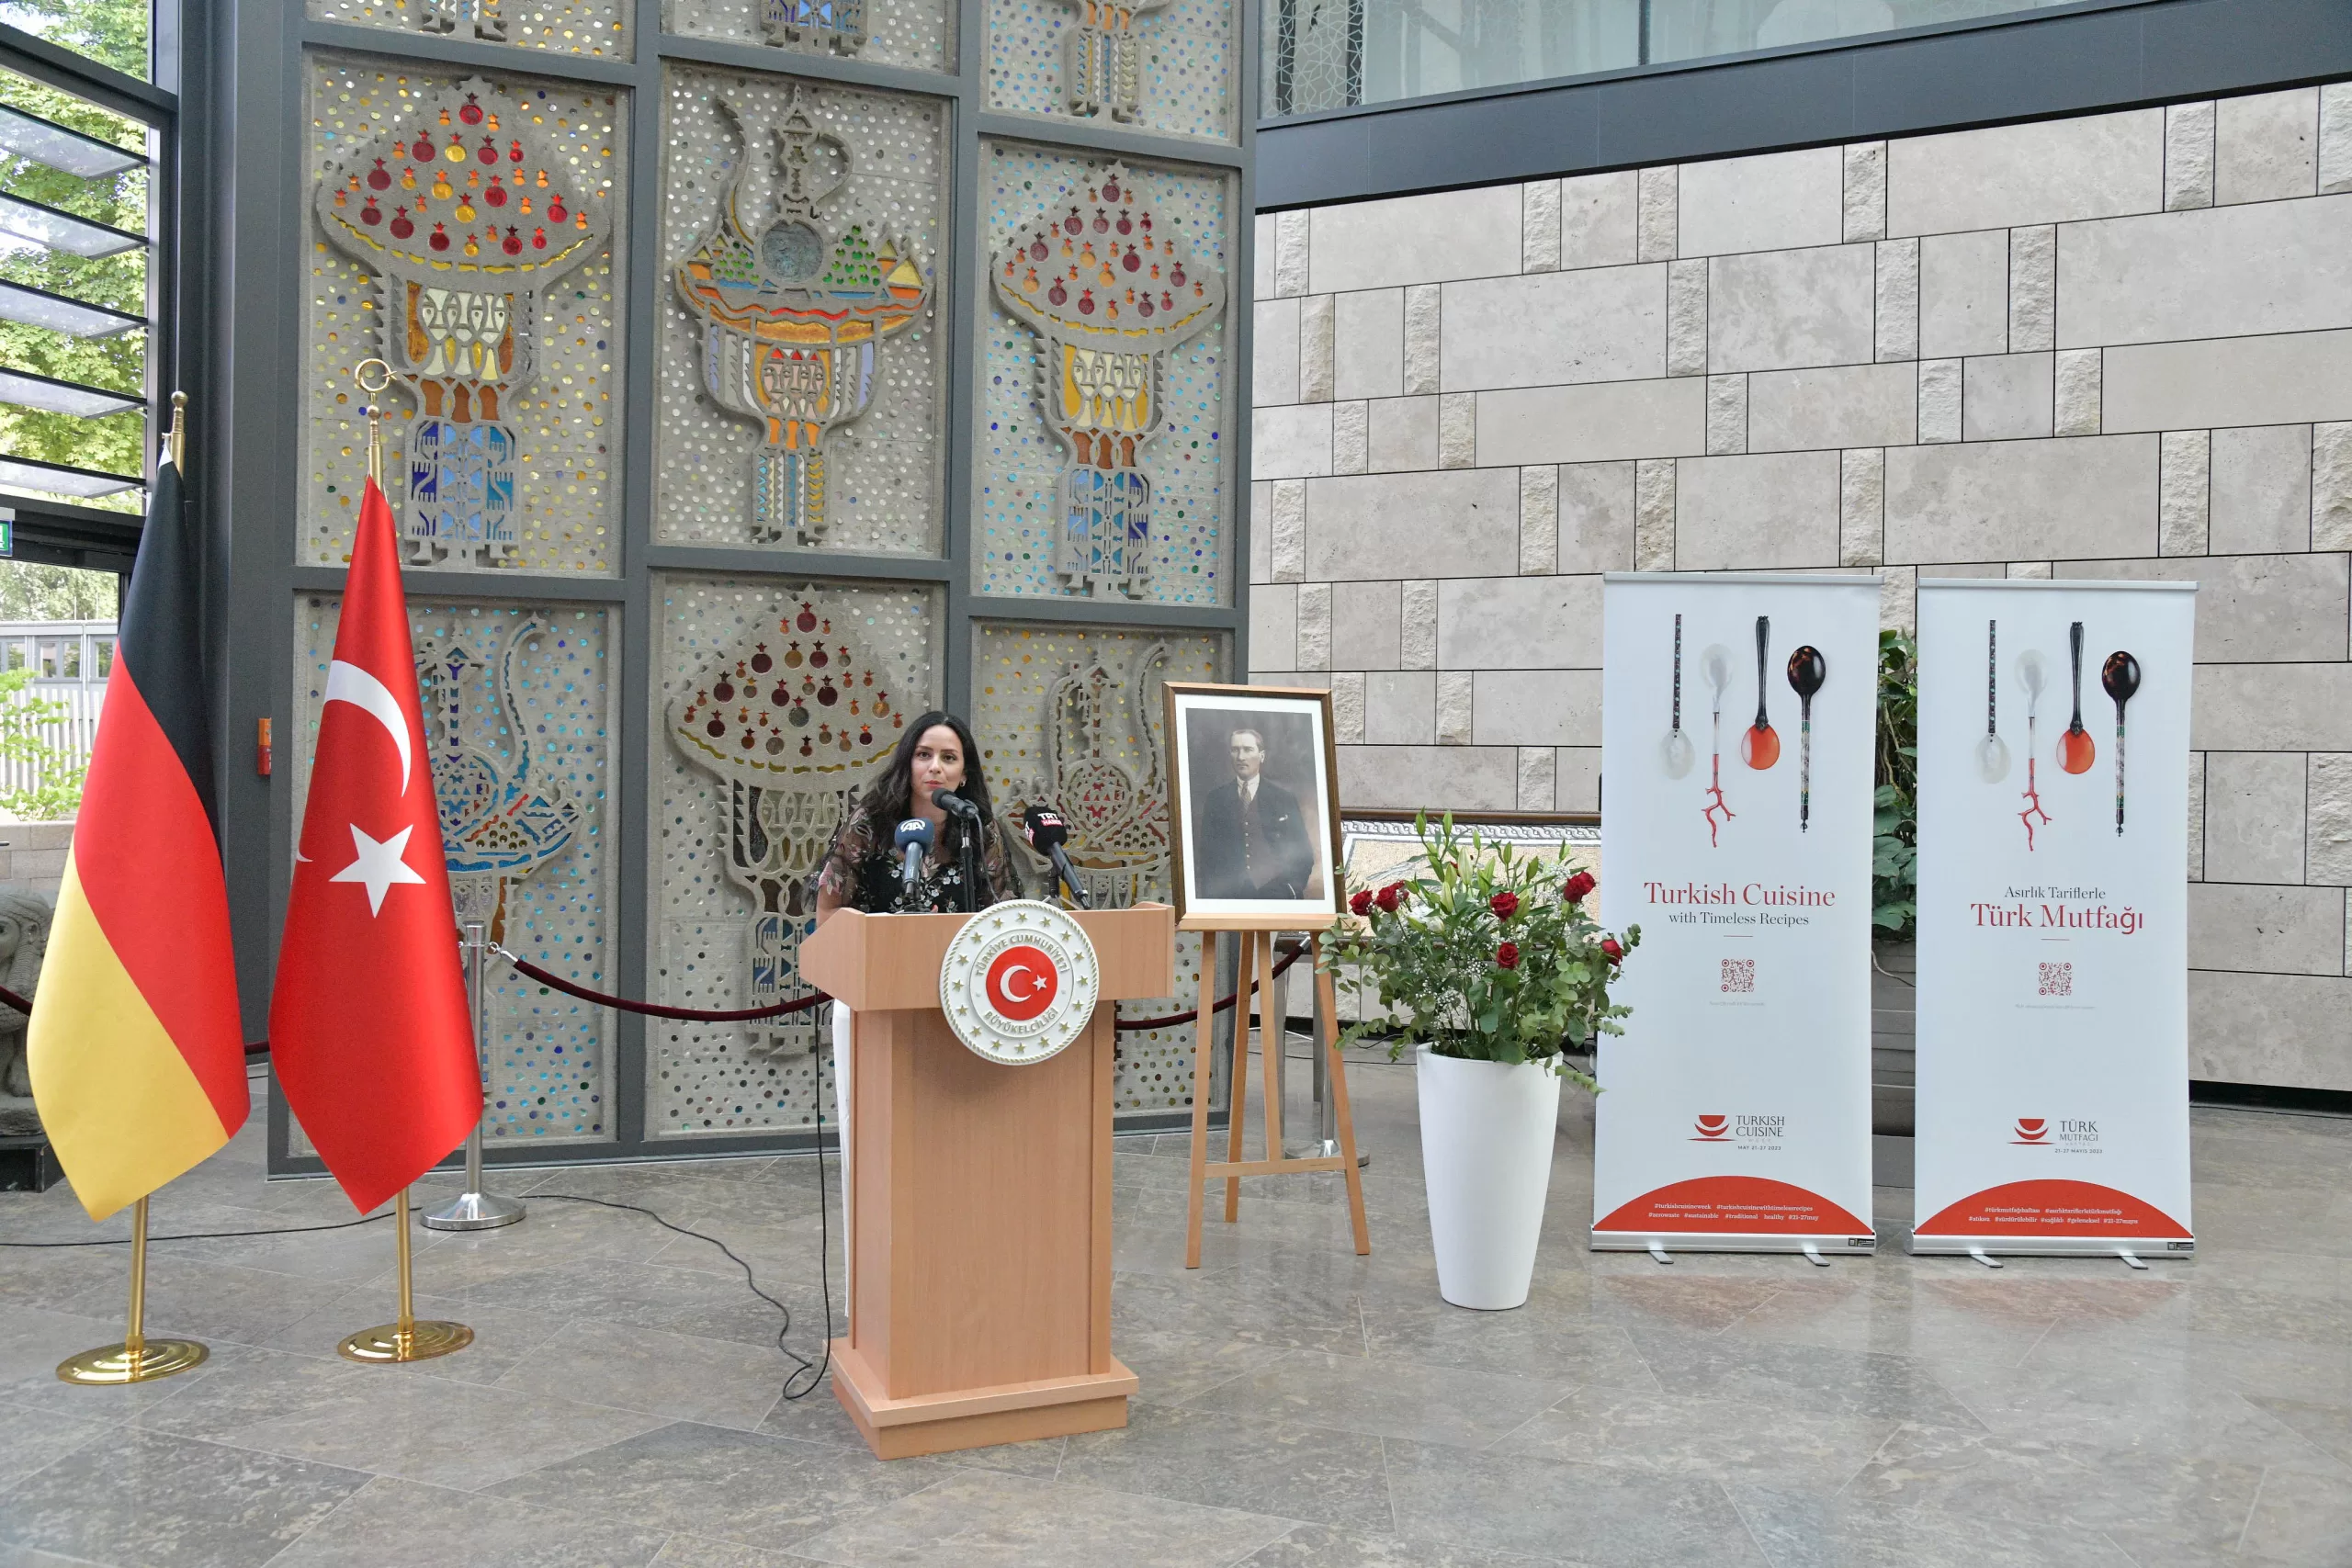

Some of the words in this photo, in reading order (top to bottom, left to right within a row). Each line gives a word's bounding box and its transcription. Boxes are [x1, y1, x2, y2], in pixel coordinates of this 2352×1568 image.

[1037, 812, 1058, 820] TRT
[1644, 882, 1736, 905] Turkish
[1743, 883, 1836, 907] Cuisine
[2004, 886, 2045, 899] Asırlık
[2048, 886, 2106, 899] Tariflerle
[1668, 912, 1697, 924] with
[1700, 911, 1756, 925] Timeless
[1760, 913, 1809, 928] Recipes
[1971, 903, 2032, 927] Türk
[2039, 904, 2143, 935] Mutfağı
[976, 941, 1008, 976] TÜRKİYE
[1010, 934, 1070, 974] CUMHURİYETİ
[1736, 1115, 1785, 1126] TURKISH
[2059, 1118, 2098, 1133] TÜRK
[1736, 1126, 1784, 1137] CUISINE
[2059, 1133, 2099, 1142] MUTFAĞI
